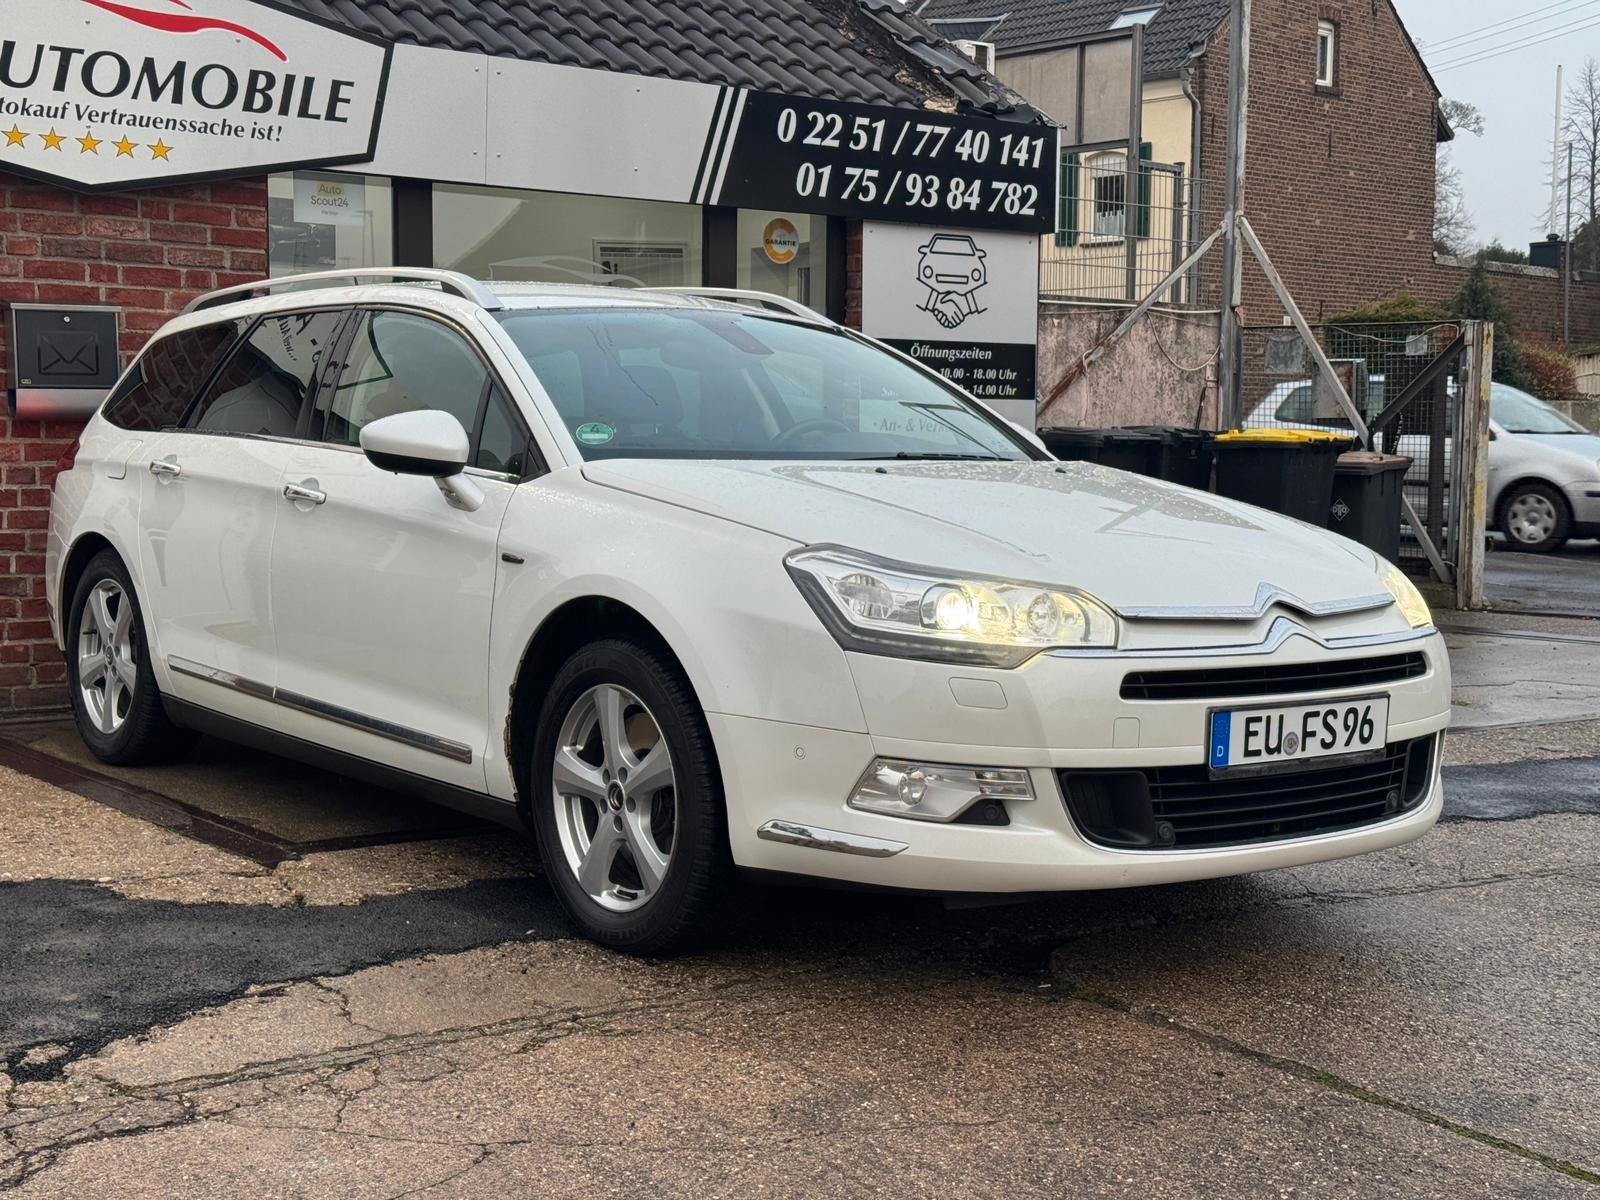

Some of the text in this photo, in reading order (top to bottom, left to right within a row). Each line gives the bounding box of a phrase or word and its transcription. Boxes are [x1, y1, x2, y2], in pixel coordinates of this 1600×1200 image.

[0, 40, 355, 123] UTOMOBILE
[74, 104, 245, 138] Vertrauenssache
[250, 121, 283, 142] ist!
[777, 108, 797, 142] 0
[803, 111, 843, 147] 22
[849, 117, 886, 151] 51
[912, 124, 950, 157] 77
[955, 129, 990, 163] 40
[1000, 134, 1045, 168] 141
[318, 184, 342, 194] Auto
[796, 162, 832, 197] 01
[841, 167, 878, 202] 75
[905, 174, 940, 207] 93
[947, 177, 980, 210] 84
[988, 181, 1037, 215] 782
[311, 196, 349, 207] Scout24
[765, 238, 797, 246] GARANTIE
[910, 343, 992, 361] Öffnungszeiten
[973, 369, 996, 379] 18.00
[999, 369, 1017, 380] Uhr
[973, 385, 996, 395] 14.00
[999, 385, 1017, 396] Uhr
[1243, 714, 1284, 758] EU
[1216, 746, 1224, 757] D
